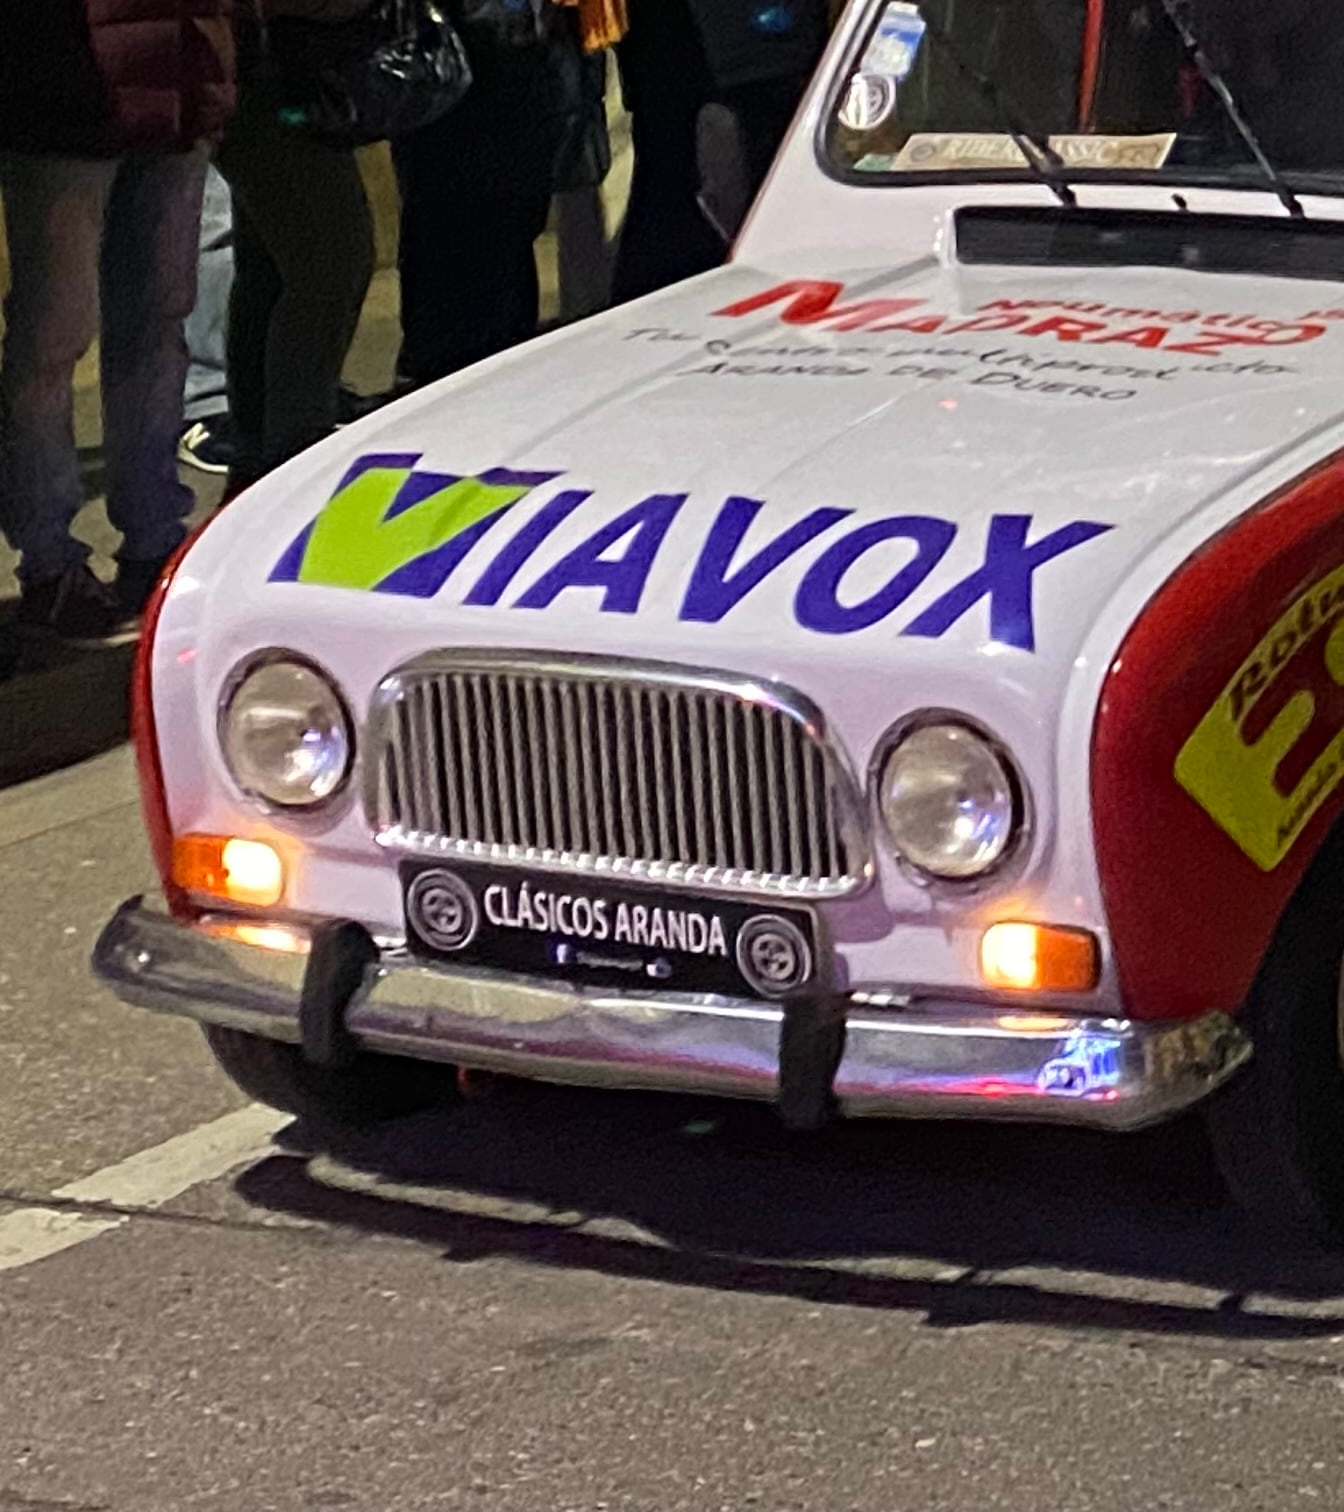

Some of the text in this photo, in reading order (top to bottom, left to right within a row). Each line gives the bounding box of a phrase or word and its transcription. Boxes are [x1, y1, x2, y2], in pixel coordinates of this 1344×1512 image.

[969, 370, 1138, 402] DUERO
[268, 453, 1116, 652] VIAVOX
[484, 880, 728, 957] CLÁSICOS ARANDA
